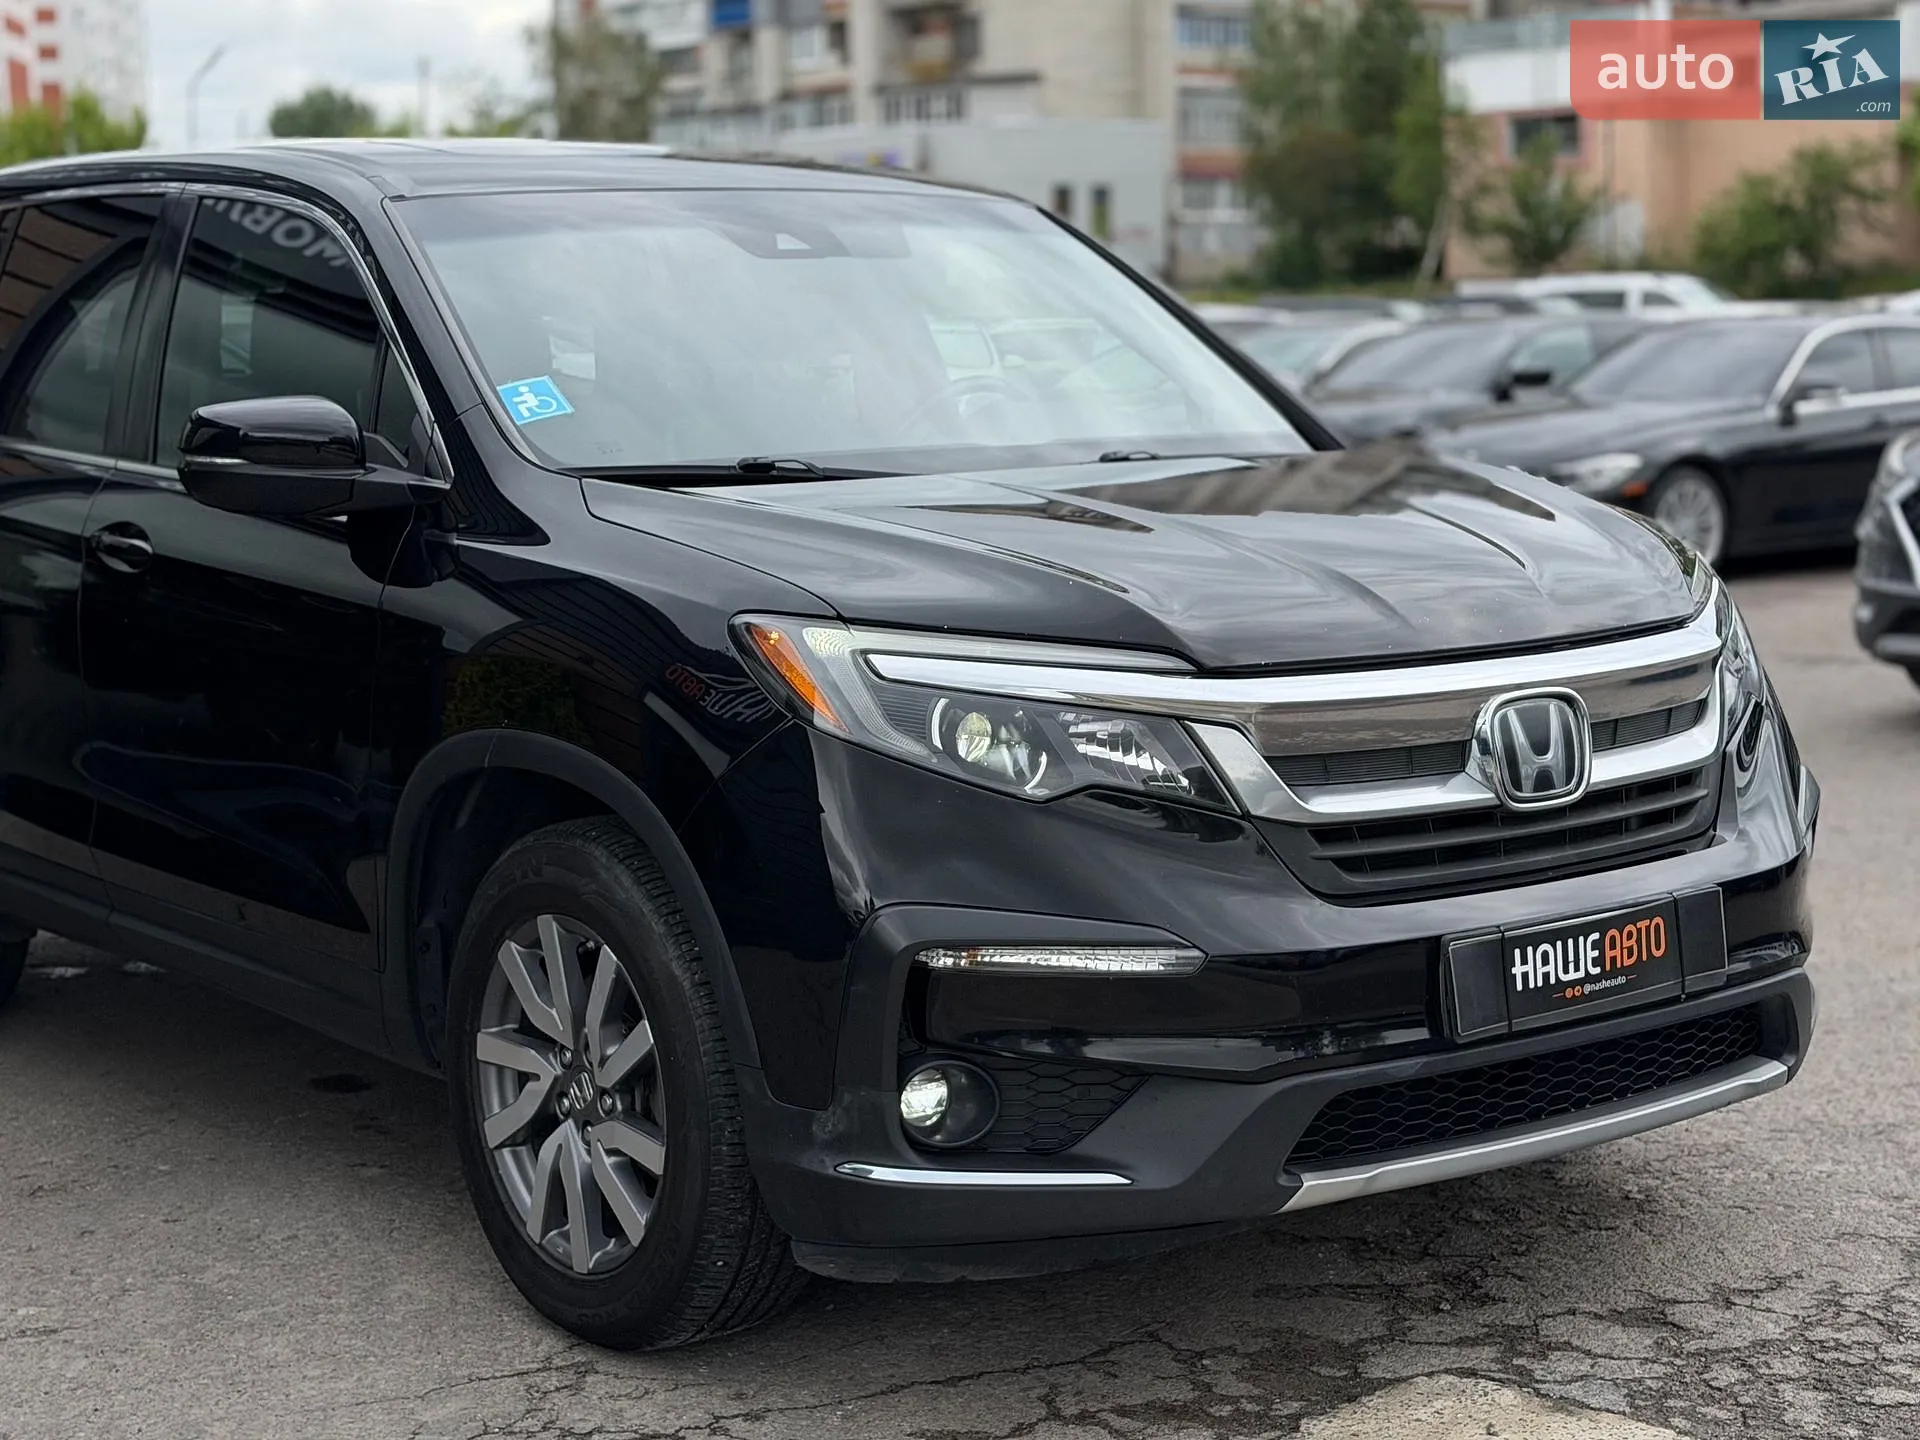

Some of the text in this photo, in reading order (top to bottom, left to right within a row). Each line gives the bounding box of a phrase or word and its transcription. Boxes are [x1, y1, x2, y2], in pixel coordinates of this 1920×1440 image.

[1511, 916, 1666, 992] НАШЕ АВТО
[1583, 975, 1627, 995] @nasheauto
